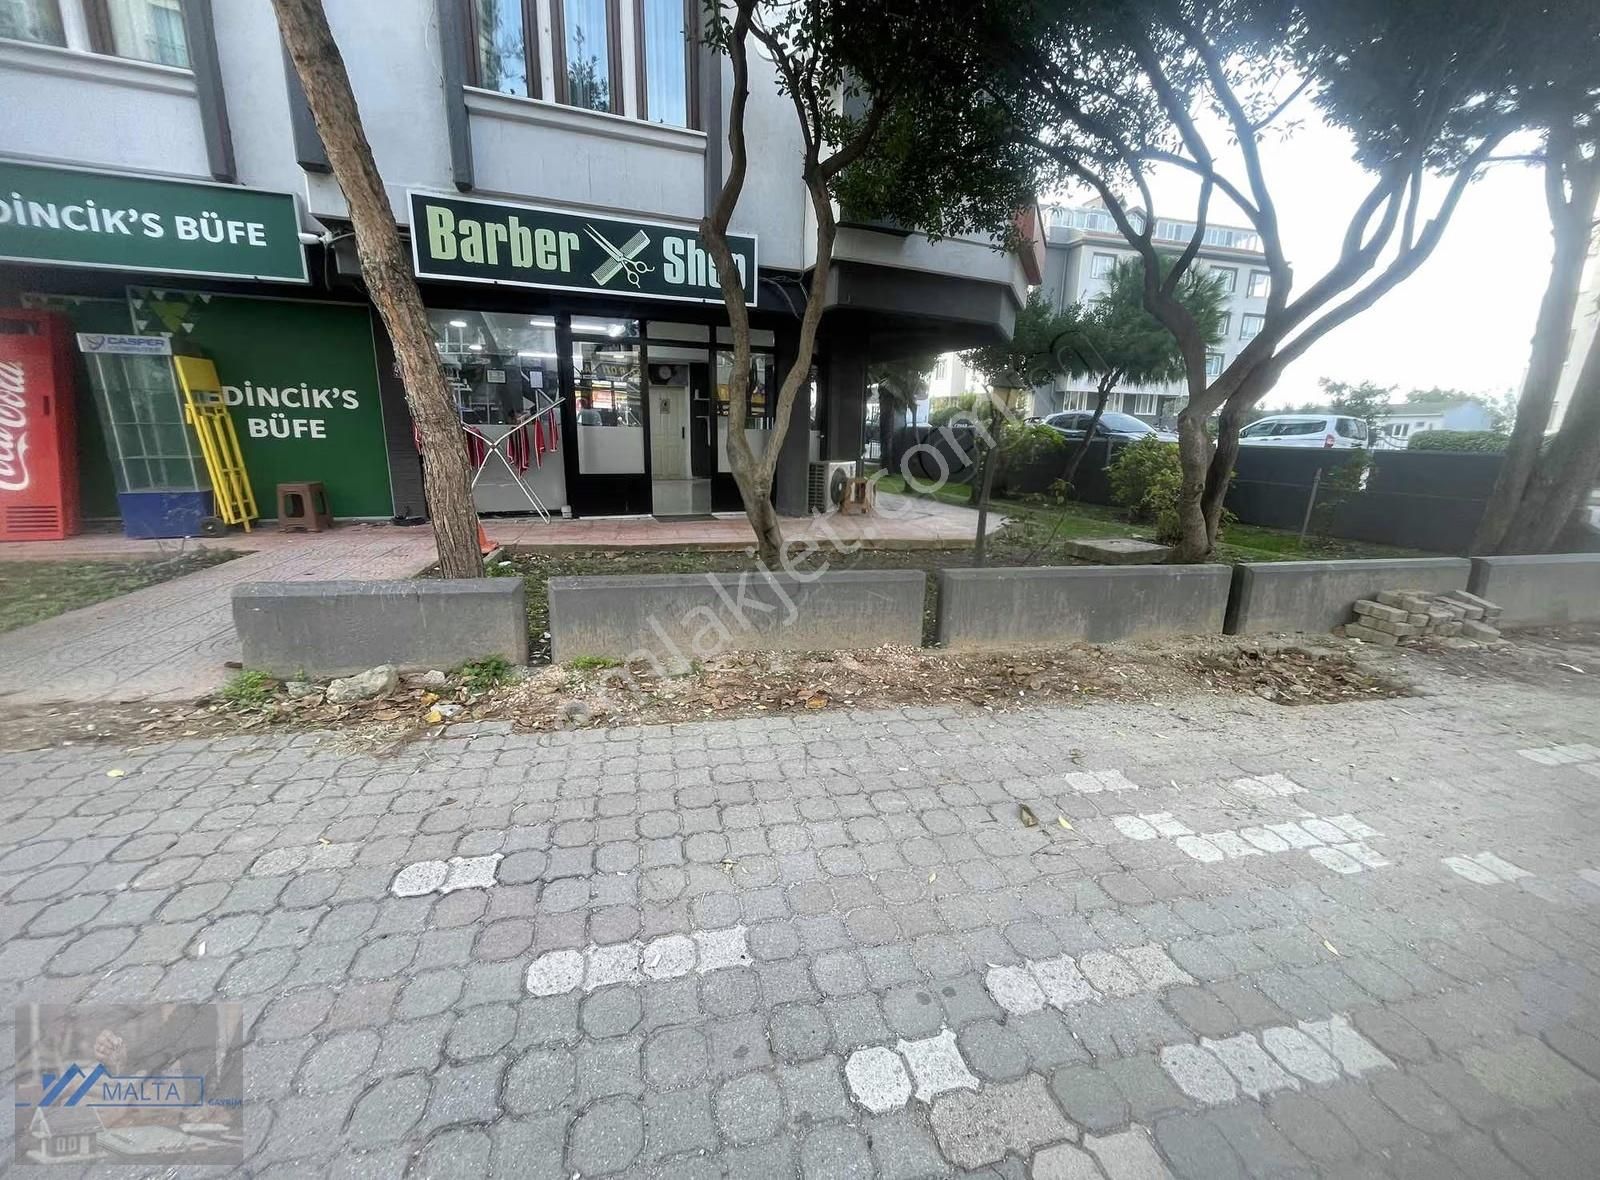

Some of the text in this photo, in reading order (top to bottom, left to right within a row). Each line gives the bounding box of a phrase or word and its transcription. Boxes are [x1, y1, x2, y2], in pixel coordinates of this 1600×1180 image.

[174, 211, 268, 248] BÜFE
[425, 203, 581, 273] Barber
[221, 380, 360, 410] DİNCİK'S
[247, 413, 327, 440] BÜFE
